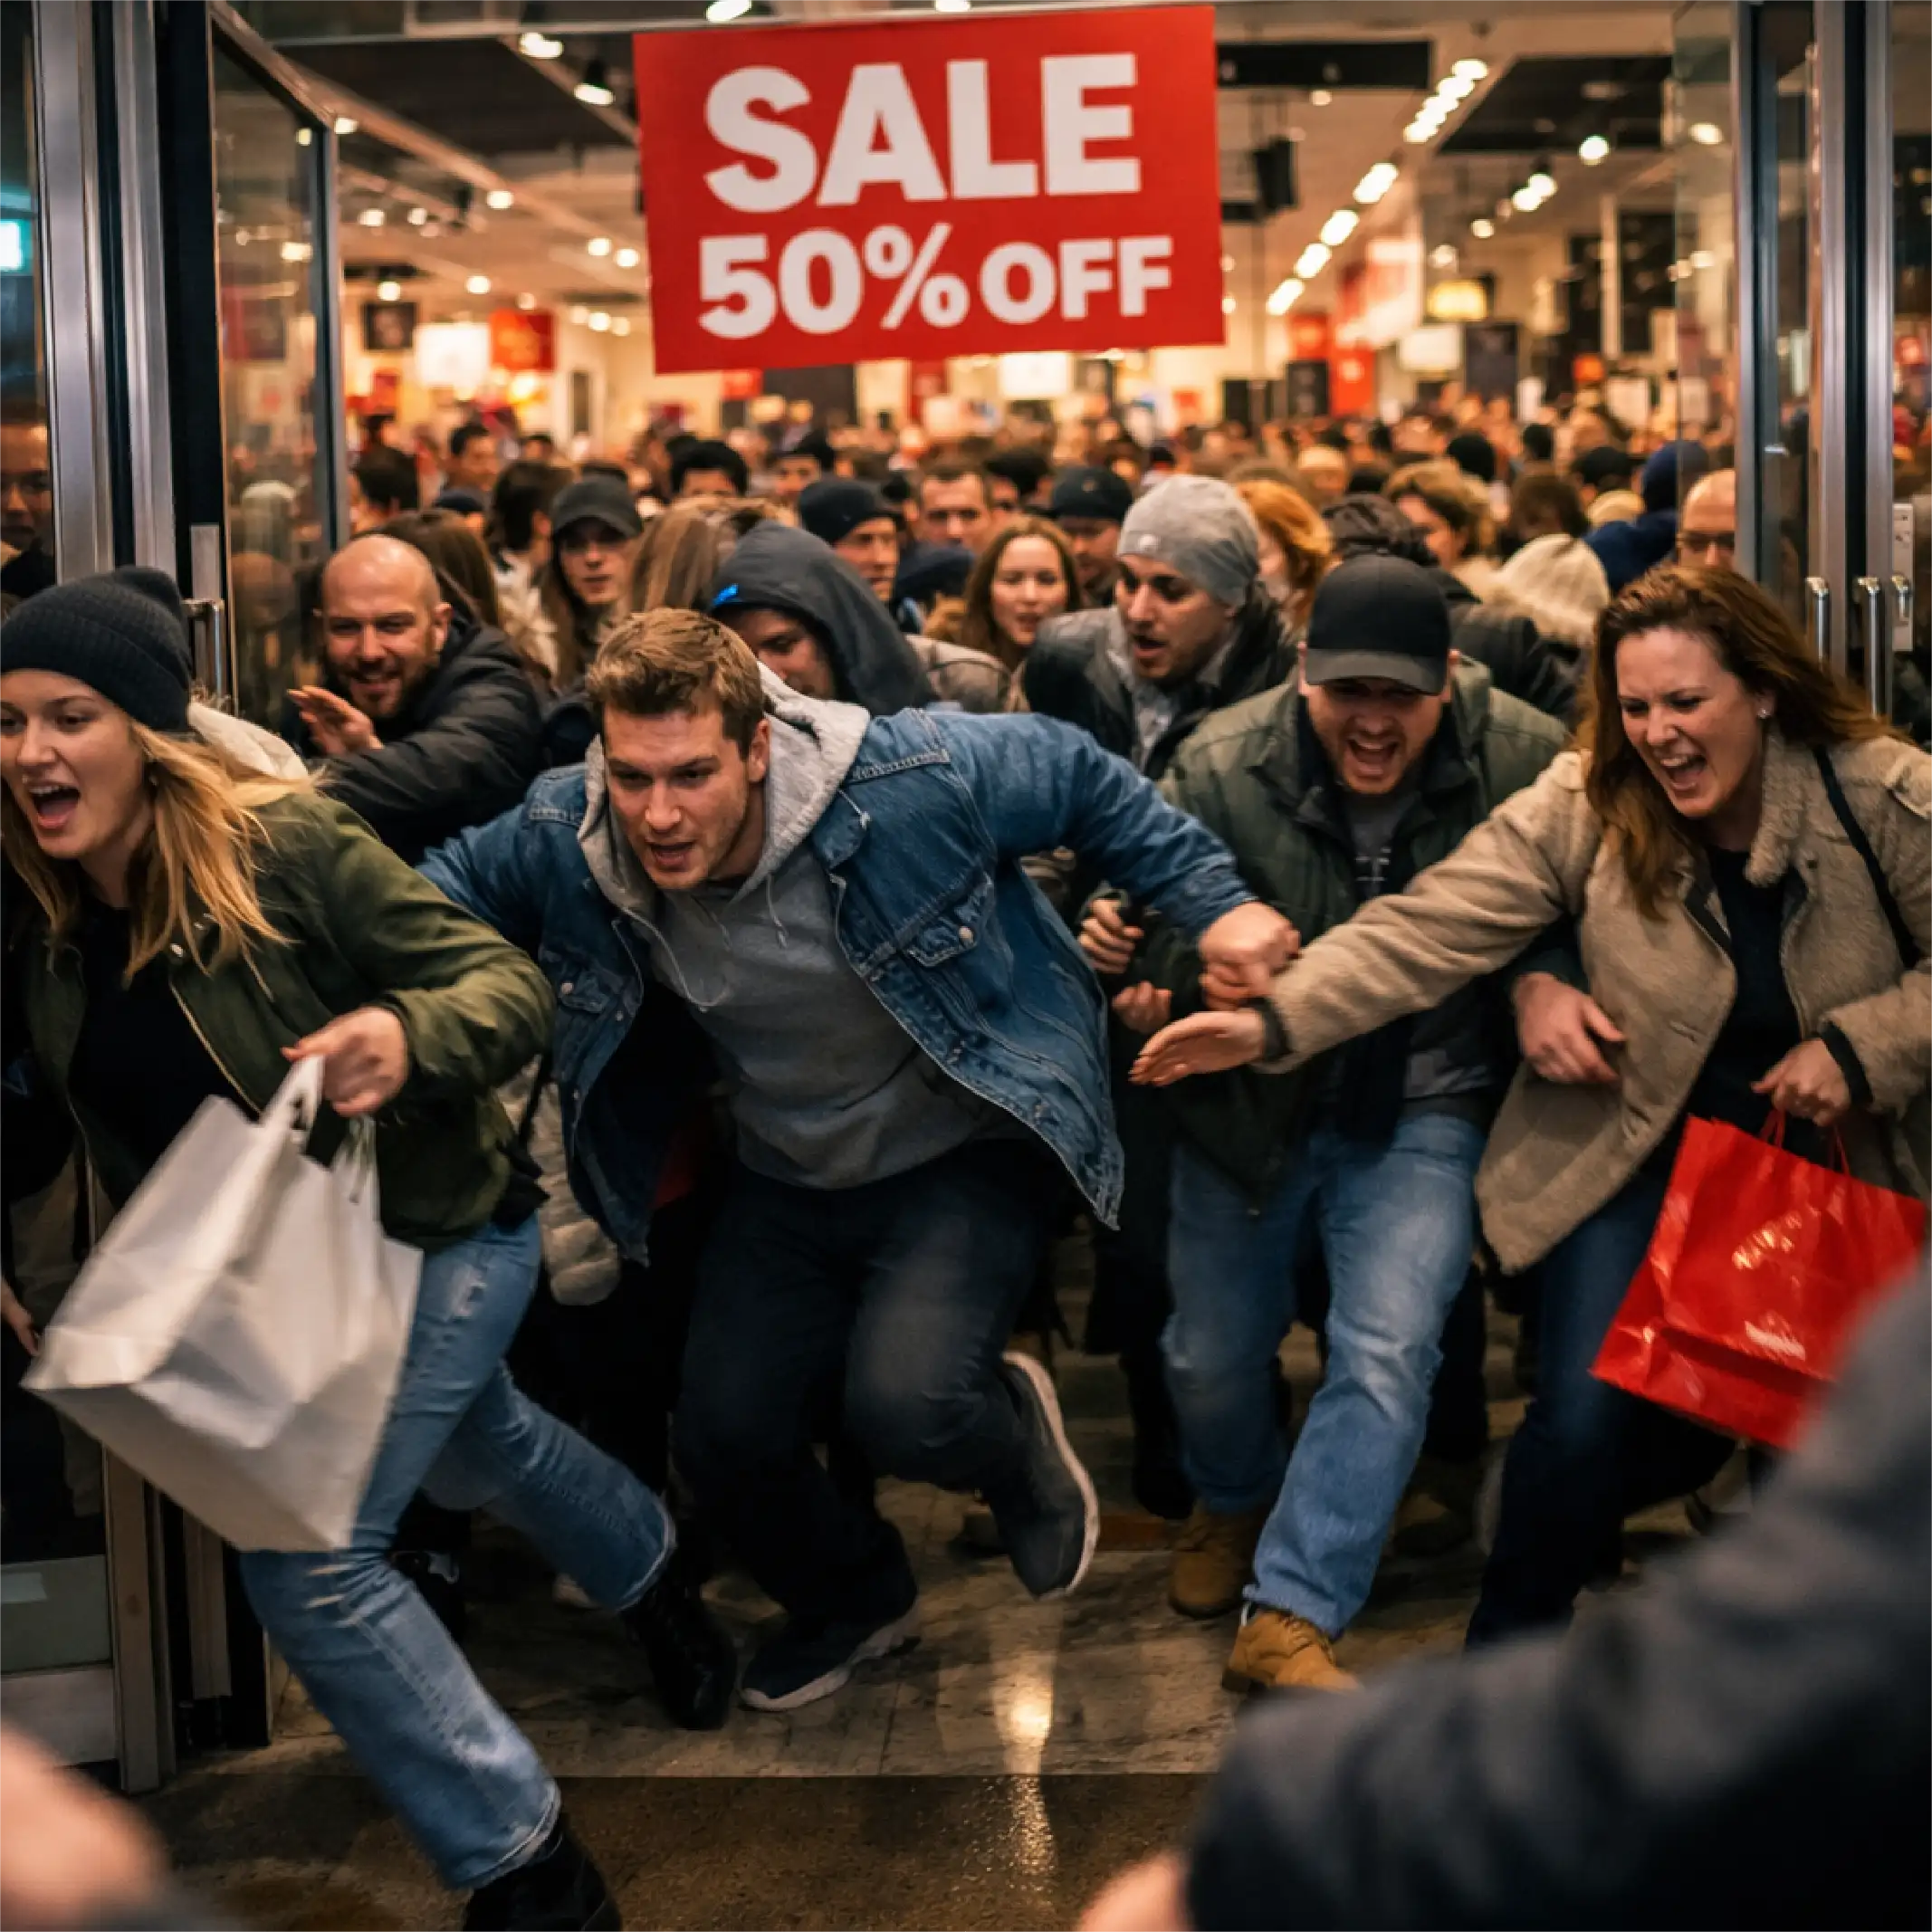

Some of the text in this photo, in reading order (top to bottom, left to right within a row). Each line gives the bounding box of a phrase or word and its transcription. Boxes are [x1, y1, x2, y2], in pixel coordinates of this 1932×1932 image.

[704, 53, 1141, 214] SALE
[698, 223, 1173, 339] 50% OFF
